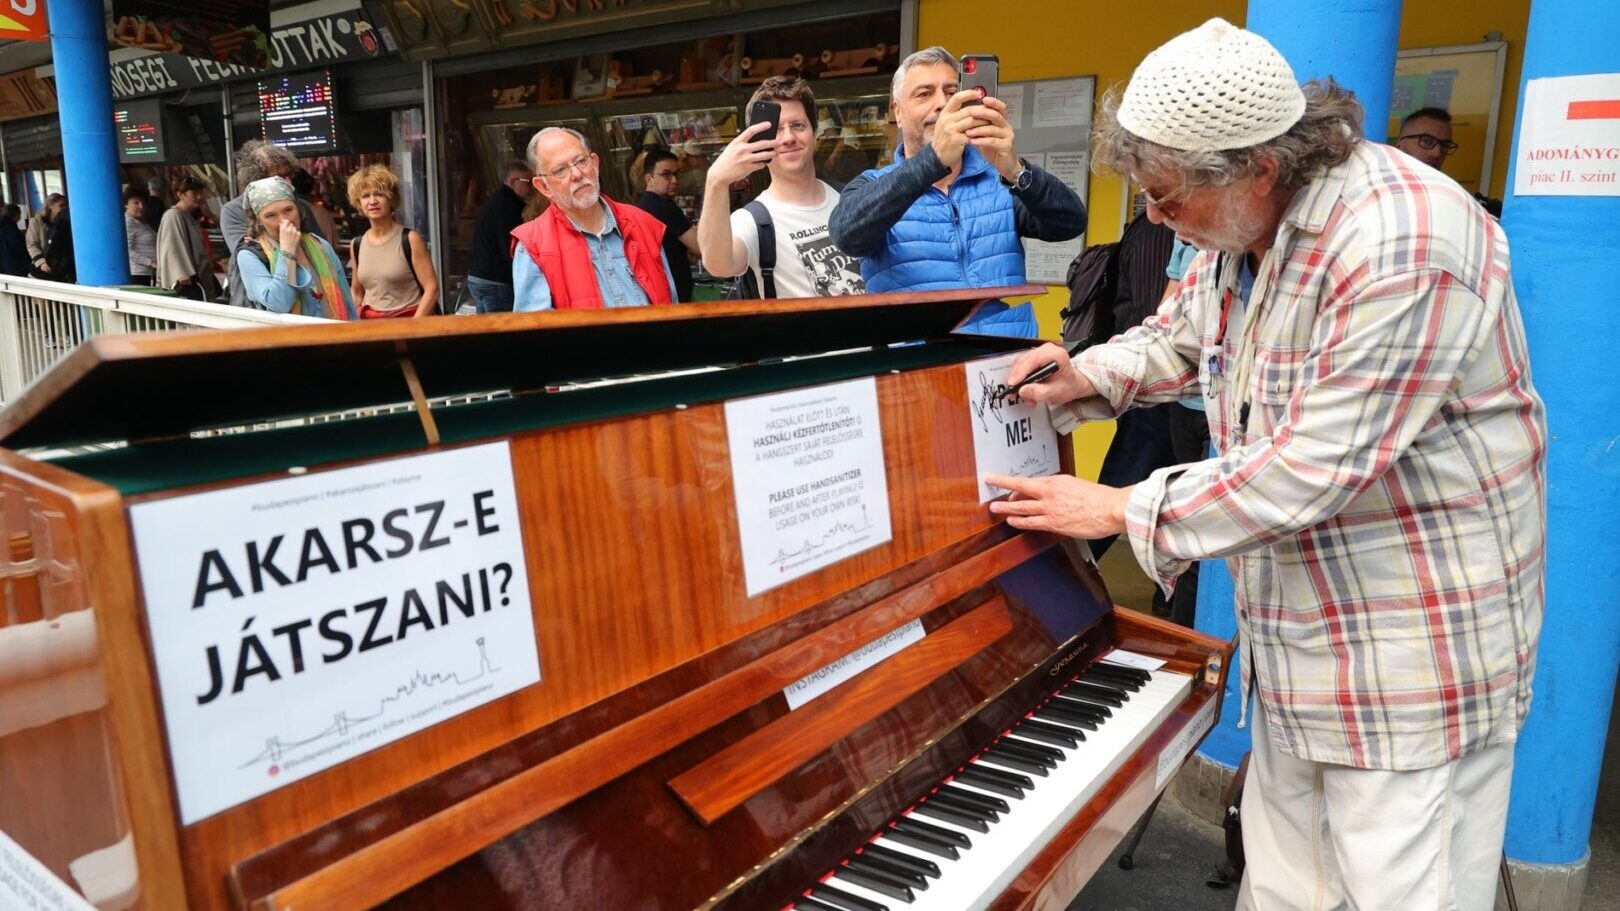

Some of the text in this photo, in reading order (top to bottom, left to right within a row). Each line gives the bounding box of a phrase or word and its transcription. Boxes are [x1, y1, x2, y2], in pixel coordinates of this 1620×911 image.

[1527, 145, 1620, 160] ADOMÁNYG
[1530, 169, 1616, 186] piac II. szint
[803, 244, 840, 266] Tum
[765, 413, 804, 430] HASZNÁLAT
[1006, 416, 1032, 447] ME!
[753, 430, 791, 448] HASZNÁLJ
[755, 451, 760, 462] A
[762, 441, 801, 461] HANGSZERT
[768, 468, 861, 504] PLEASE USE HANDSANITIZER
[768, 501, 793, 518] BEFORE
[795, 496, 809, 510] AND
[811, 490, 829, 505] AFTER
[775, 514, 797, 531] USAGE
[798, 510, 810, 523] ON
[810, 504, 829, 519] YOUR
[830, 499, 845, 513] OWN
[191, 489, 500, 609] AKARSZ-E
[196, 562, 513, 706] JÁTSZANI?
